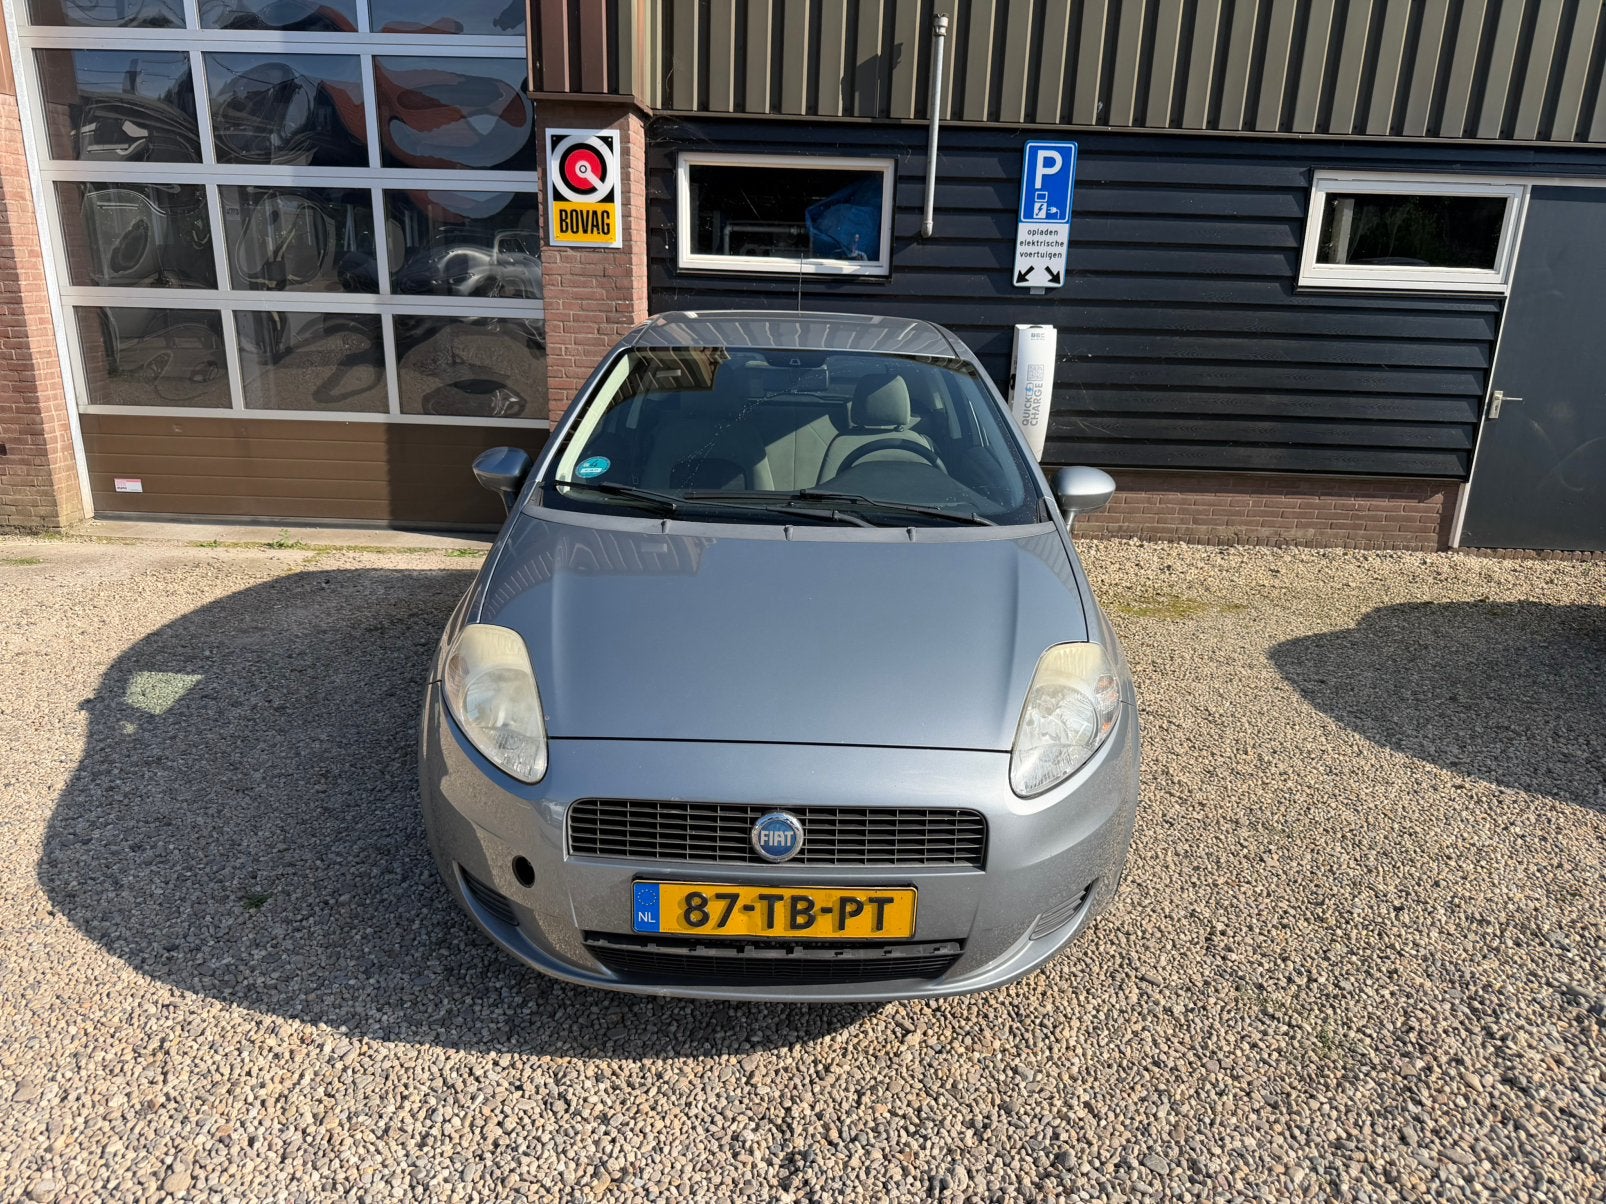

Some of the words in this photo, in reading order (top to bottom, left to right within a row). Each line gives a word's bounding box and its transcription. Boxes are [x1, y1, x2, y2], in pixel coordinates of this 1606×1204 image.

[1035, 150, 1063, 189] P
[559, 209, 611, 235] BOVAG
[1027, 228, 1059, 236] opladen
[1019, 239, 1065, 248] elektrische
[1019, 251, 1063, 260] voertuigen
[1022, 396, 1033, 426] QUICK
[1030, 383, 1043, 427] CHARGE
[760, 830, 794, 847] FIAT
[638, 911, 656, 923] NL
[683, 891, 895, 931] 87-TB-PT
